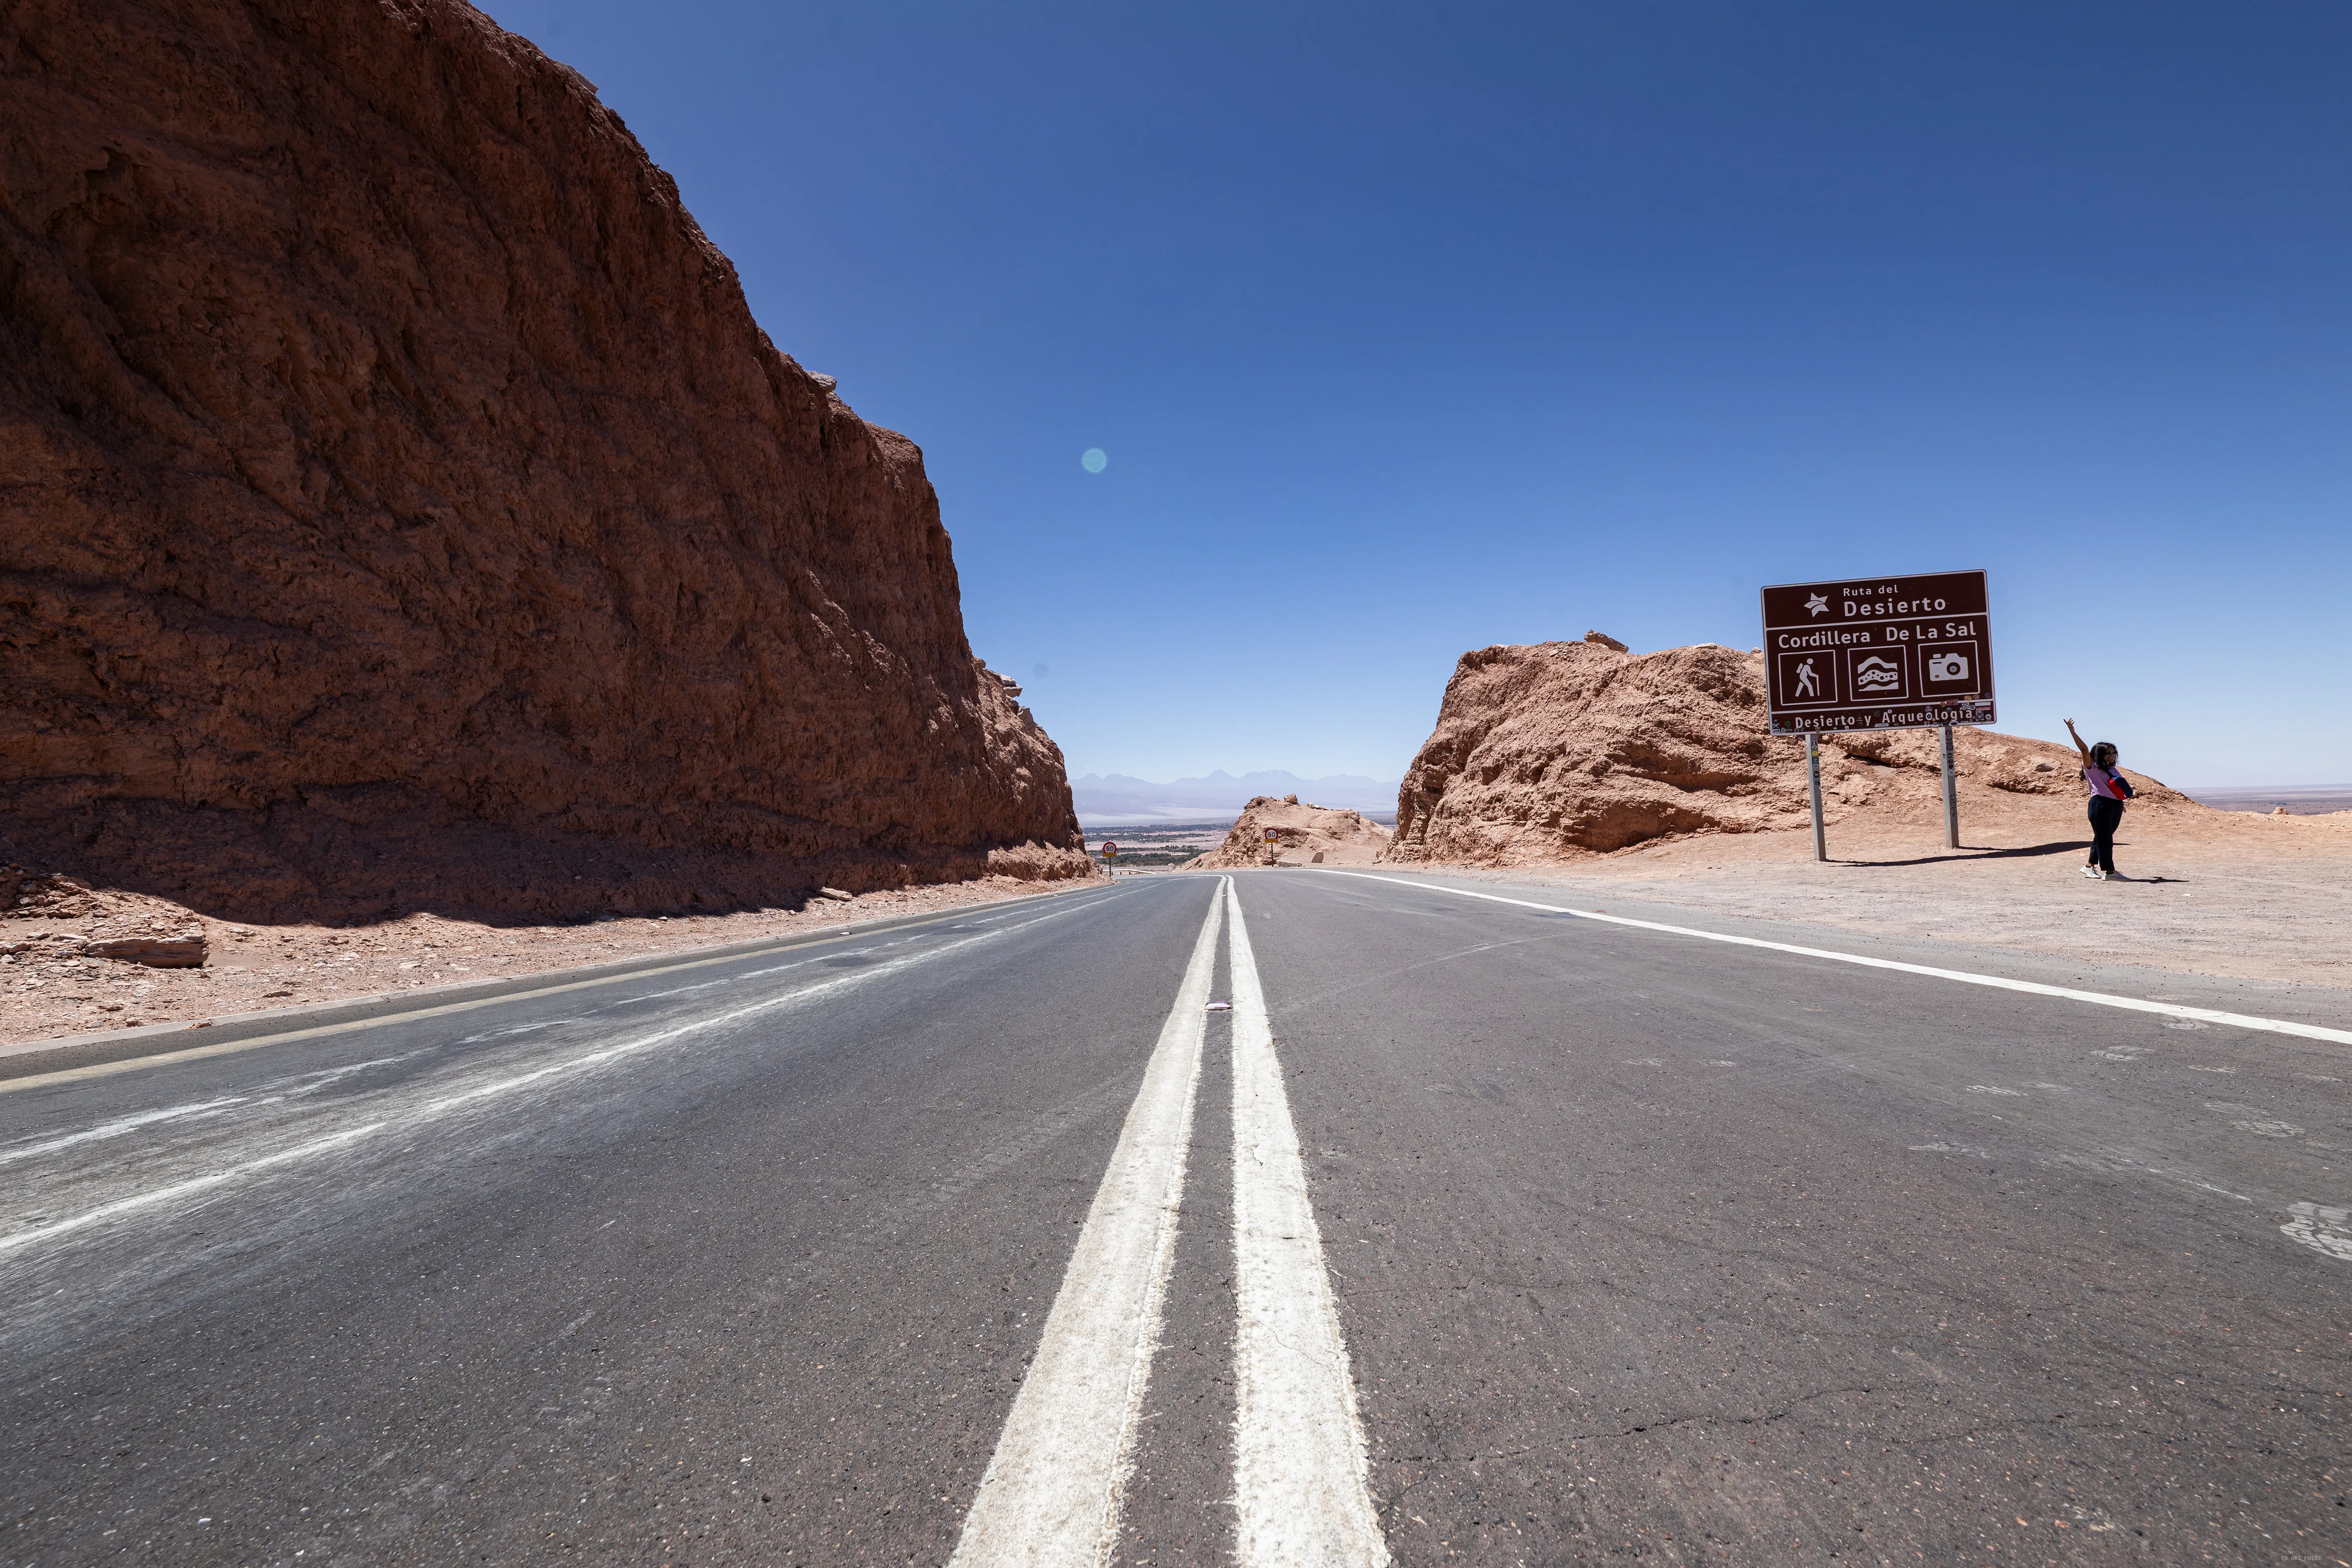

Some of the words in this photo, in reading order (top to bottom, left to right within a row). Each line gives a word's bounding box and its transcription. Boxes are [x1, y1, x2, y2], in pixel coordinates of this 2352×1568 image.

[1843, 588, 1872, 597] Ruta
[1878, 585, 1898, 594] del
[1844, 598, 1946, 617] Desierto
[1779, 630, 1870, 648] Cordillera
[1886, 627, 1909, 641] De
[1916, 625, 1938, 639] La
[1946, 621, 1976, 637] Sal
[1795, 715, 1855, 728] Desierto
[1864, 716, 1871, 726] y
[1882, 708, 1972, 724] Arqueología
